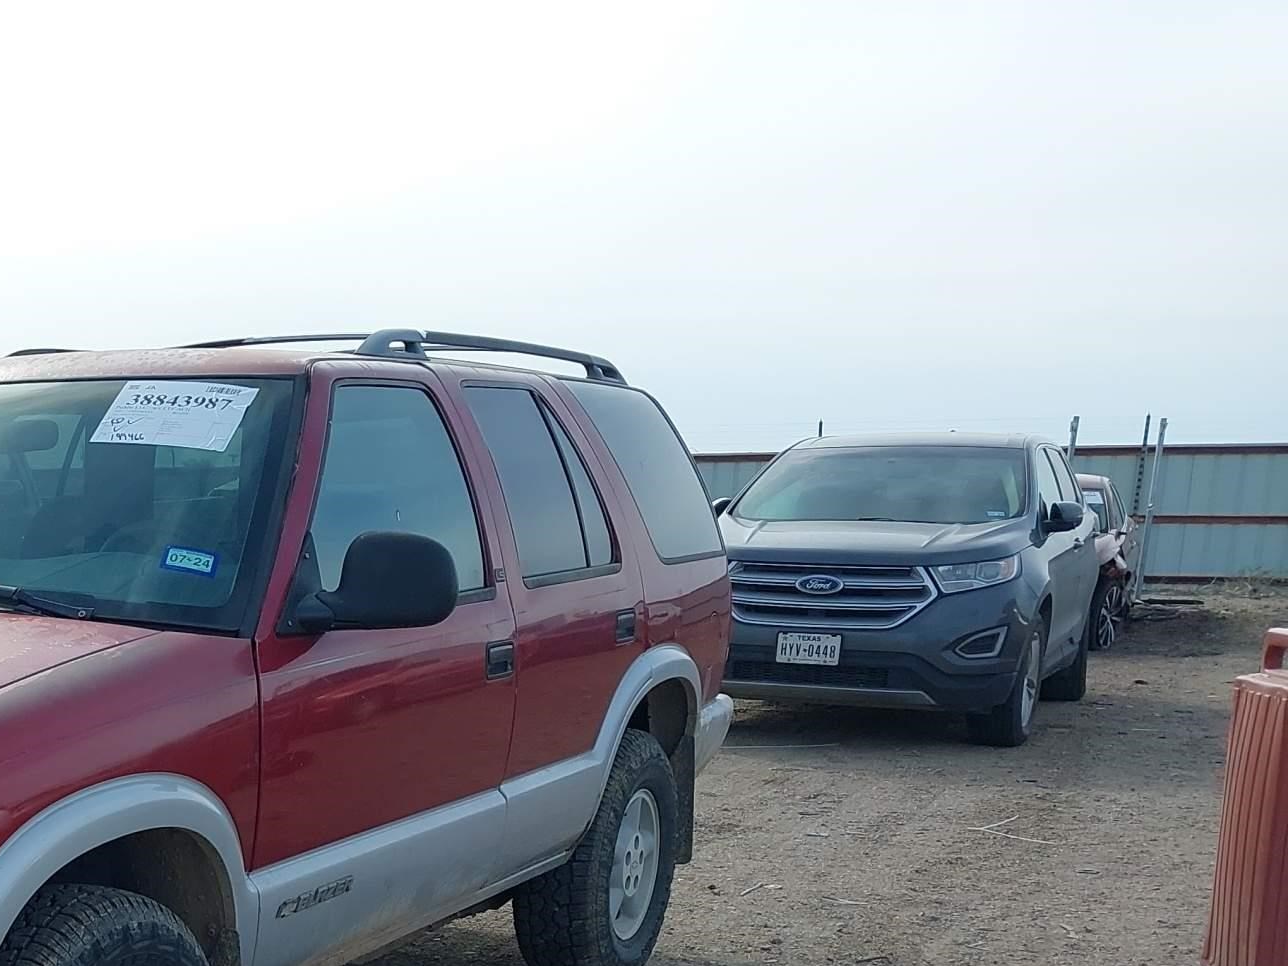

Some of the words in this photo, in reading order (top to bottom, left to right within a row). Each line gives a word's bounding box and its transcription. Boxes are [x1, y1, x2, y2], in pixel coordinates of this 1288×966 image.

[126, 393, 234, 410] 38843987
[169, 553, 210, 568] 07-24
[806, 578, 832, 590] Ford
